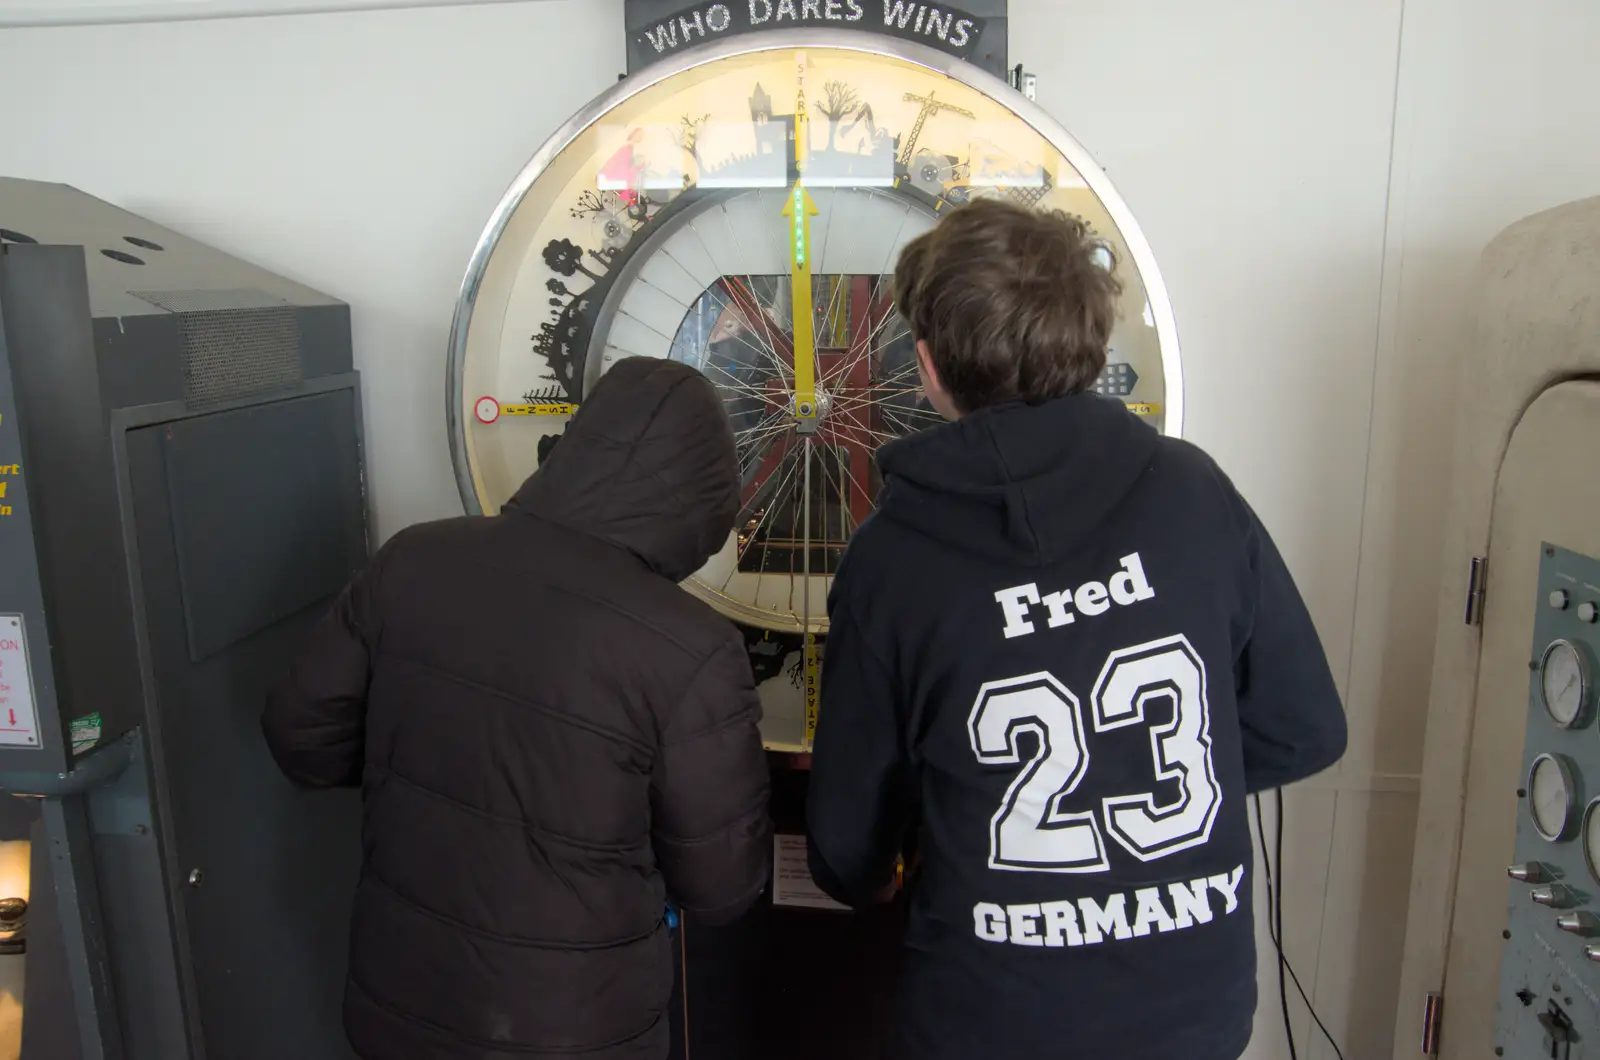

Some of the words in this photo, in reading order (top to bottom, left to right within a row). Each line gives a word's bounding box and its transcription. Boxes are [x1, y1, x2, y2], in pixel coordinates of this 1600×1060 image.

[644, 3, 731, 53] WHO
[749, 0, 864, 25] DARES
[883, 0, 974, 47] WINS
[796, 63, 805, 122] START
[506, 405, 569, 415] FINISH
[993, 551, 1155, 639] Fred
[0, 639, 18, 651] ON
[807, 676, 816, 729] STAGE
[967, 633, 1222, 873] 23
[973, 864, 1244, 947] GERMANY
